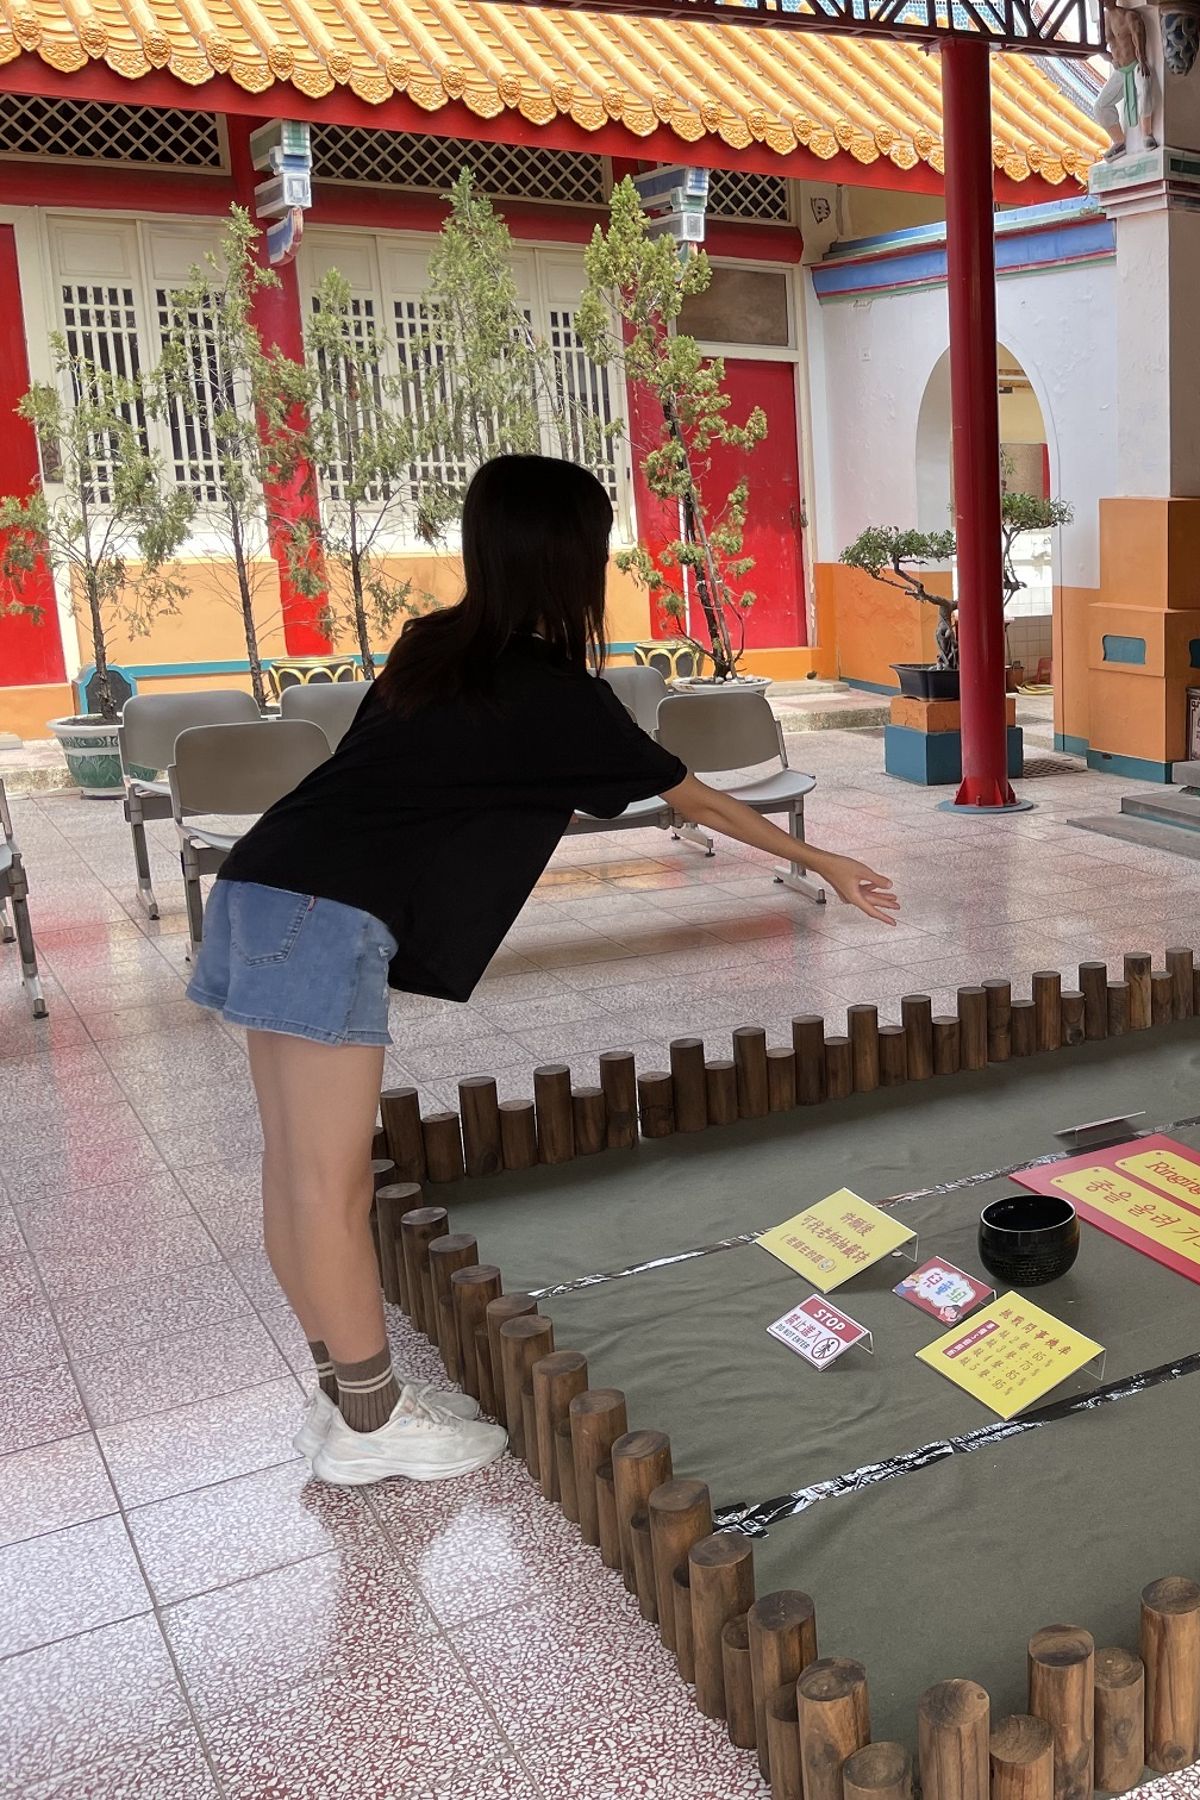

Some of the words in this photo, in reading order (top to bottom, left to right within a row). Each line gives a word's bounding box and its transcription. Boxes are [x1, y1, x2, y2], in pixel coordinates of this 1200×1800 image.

[784, 1313, 822, 1343] 禁止進入
[812, 1308, 846, 1331] STOP
[783, 1328, 796, 1339] NOT
[792, 1333, 811, 1350] ENTER
